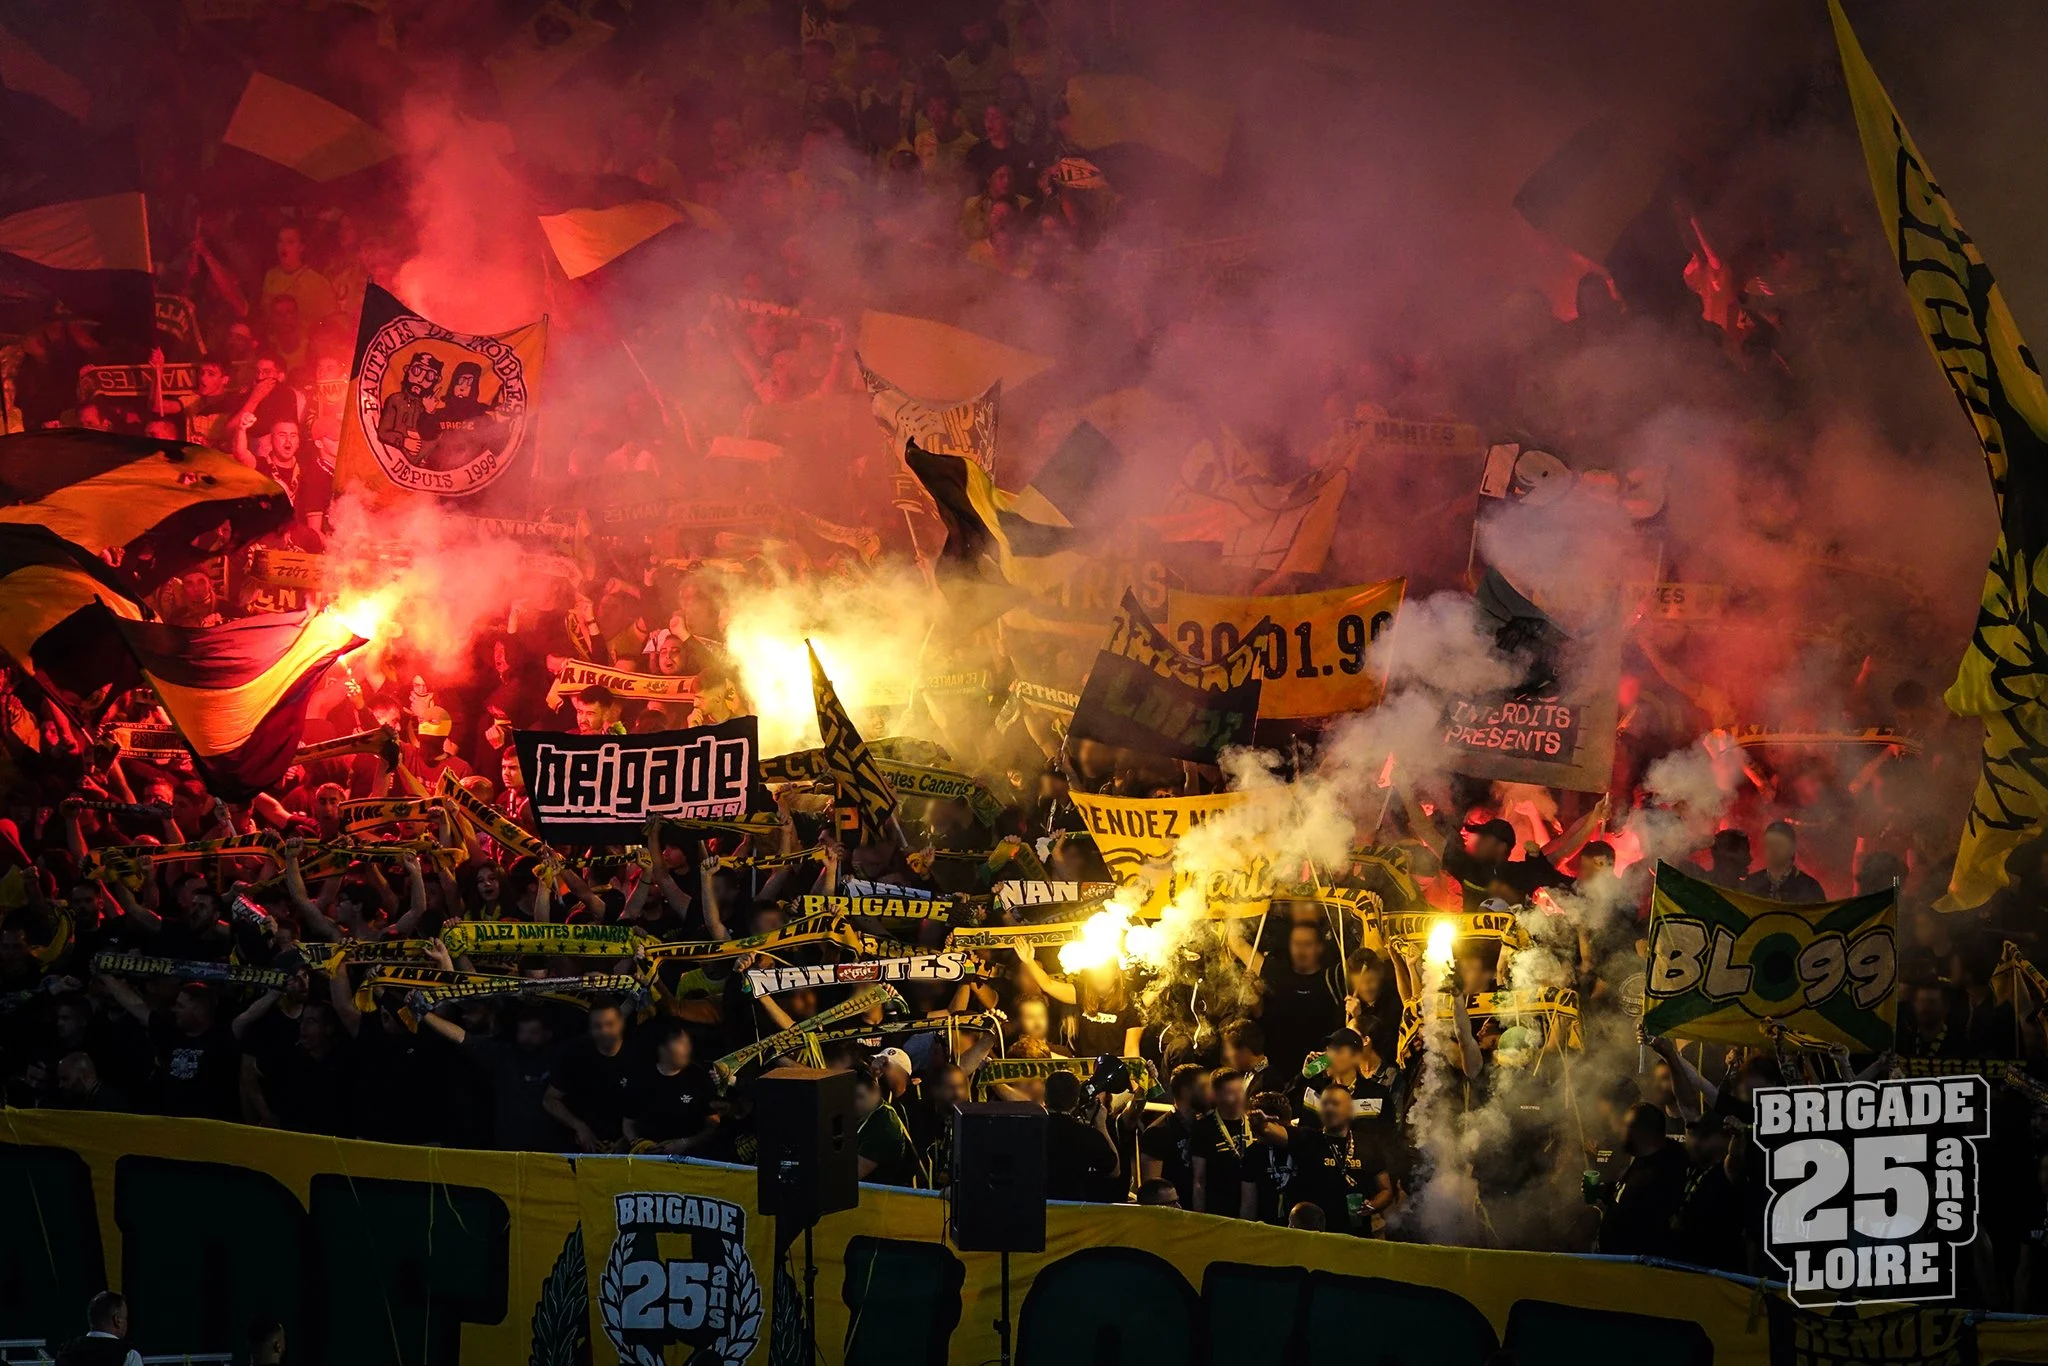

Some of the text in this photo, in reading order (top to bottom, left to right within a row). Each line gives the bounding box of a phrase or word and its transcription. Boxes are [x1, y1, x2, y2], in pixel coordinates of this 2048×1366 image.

[424, 322, 455, 341] DE
[391, 453, 498, 489] DEPUIS 1999
[559, 666, 637, 692] RIBUNE
[1450, 700, 1571, 729] INRDITS
[1443, 724, 1562, 755] PRESENTS
[537, 736, 749, 816] brigade
[918, 773, 972, 795] Canaris
[686, 801, 742, 820] 1999
[803, 894, 954, 922] BRIGADE
[1000, 880, 1079, 911] NAN
[473, 923, 629, 943] ALLEZ NANTES CANARIS
[777, 913, 847, 941] LOIRE
[1472, 914, 1511, 932] LOIR
[580, 975, 640, 992] LOIR
[830, 989, 881, 1021] LOIRE
[979, 1060, 1064, 1083] RIBUN
[618, 1195, 738, 1235] BRIGADE
[621, 1260, 728, 1330] 25 ans
